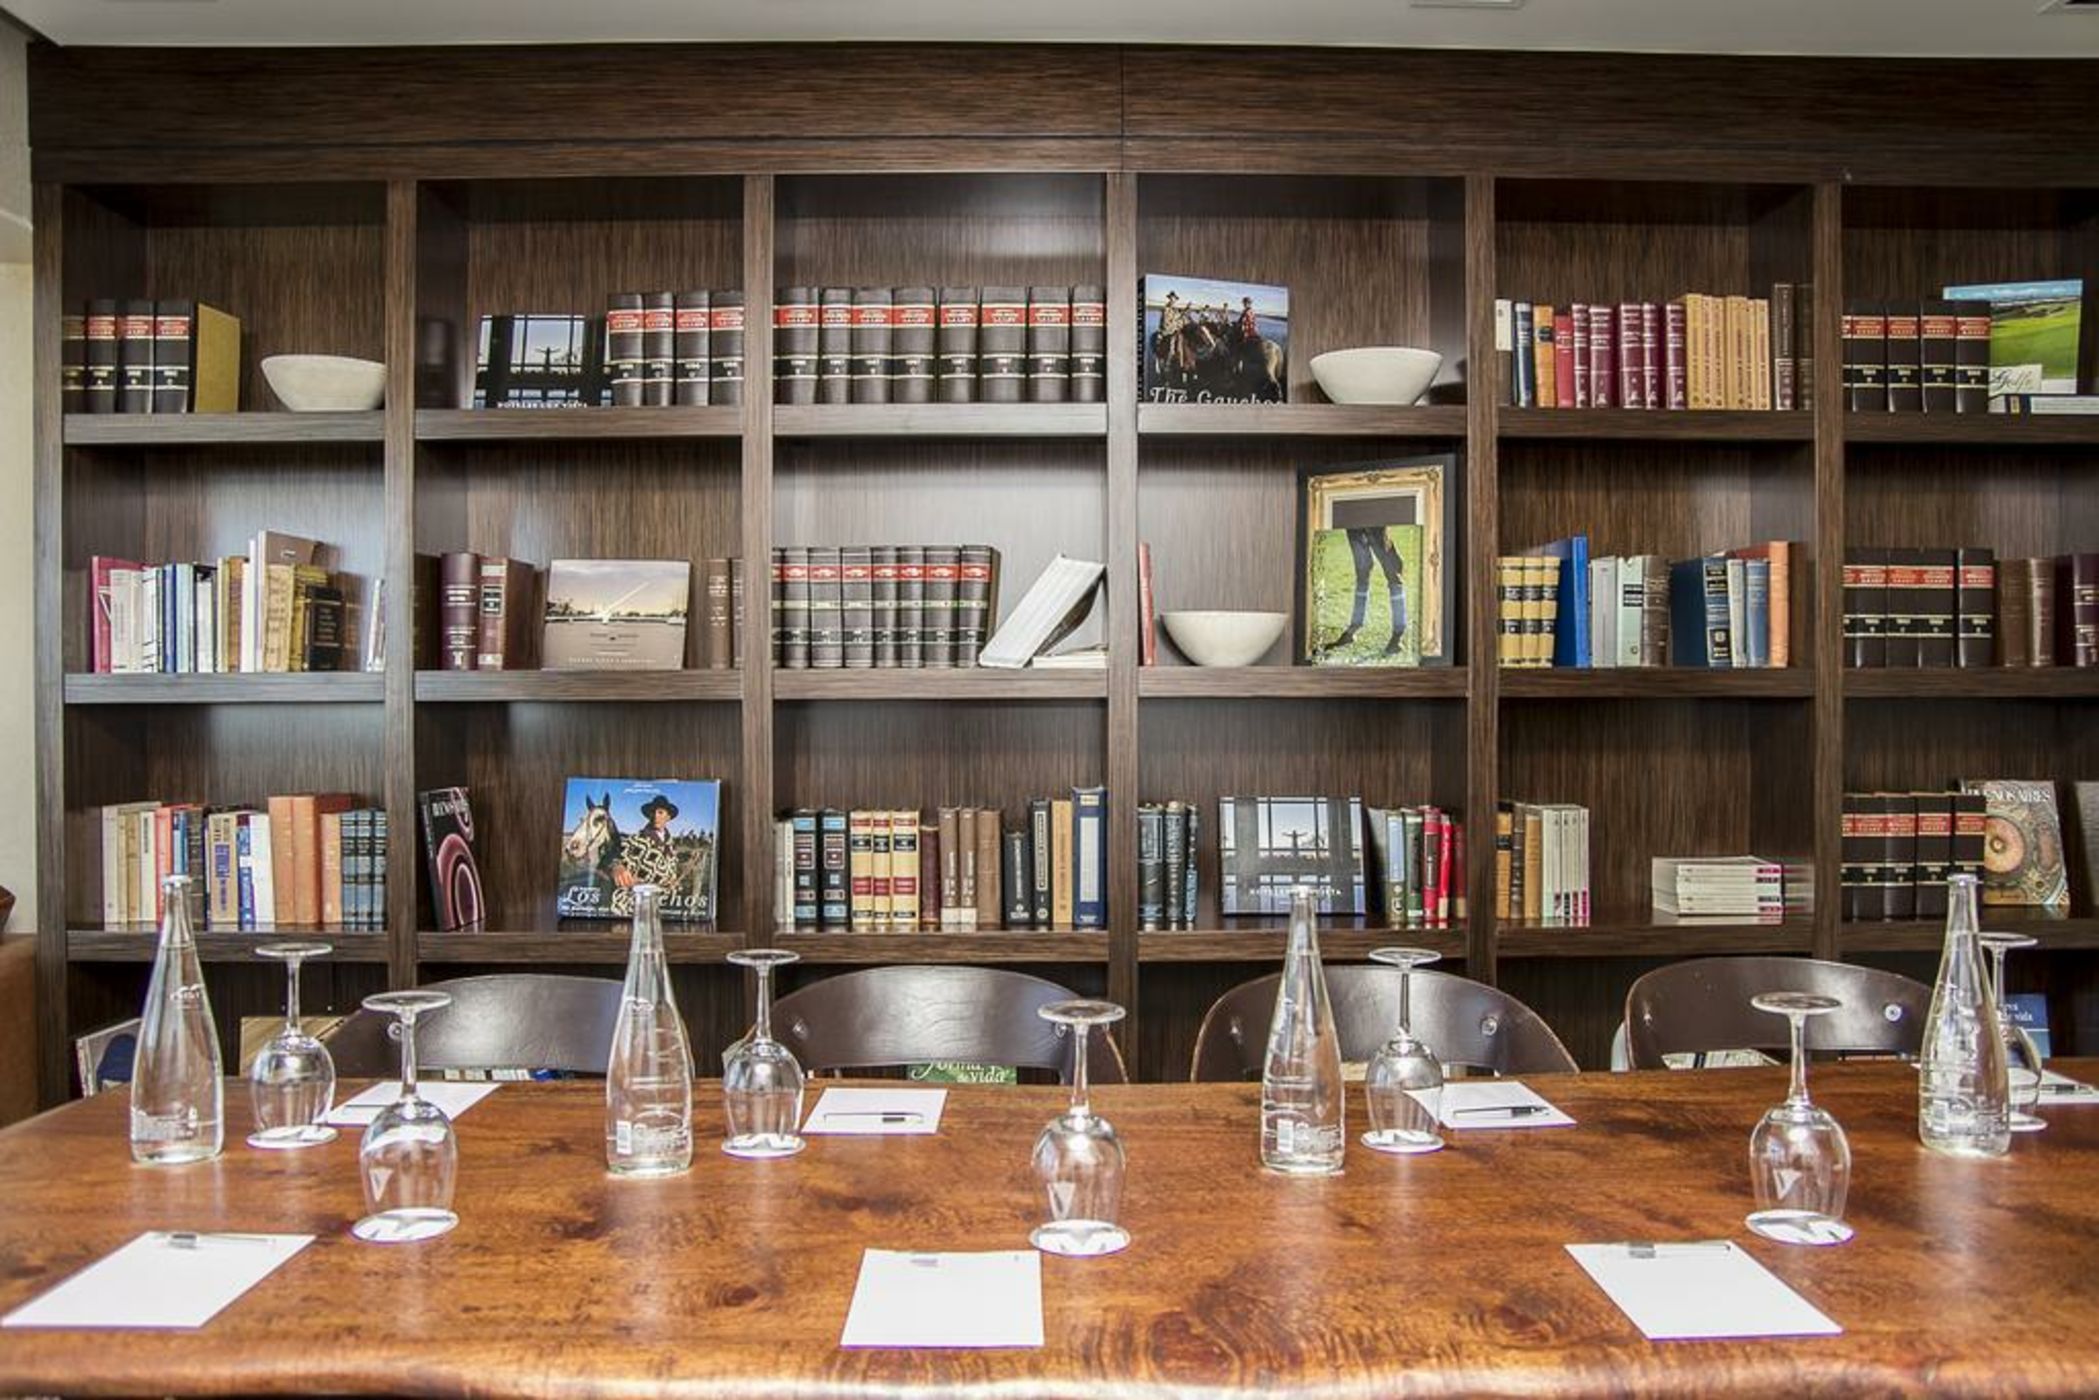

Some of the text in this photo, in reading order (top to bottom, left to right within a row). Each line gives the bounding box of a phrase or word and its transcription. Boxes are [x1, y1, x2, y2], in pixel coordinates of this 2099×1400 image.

[1150, 387, 1284, 404] The Gauch
[564, 886, 601, 905] Los
[612, 887, 709, 911] Gachos
[969, 1066, 1006, 1083] vida
